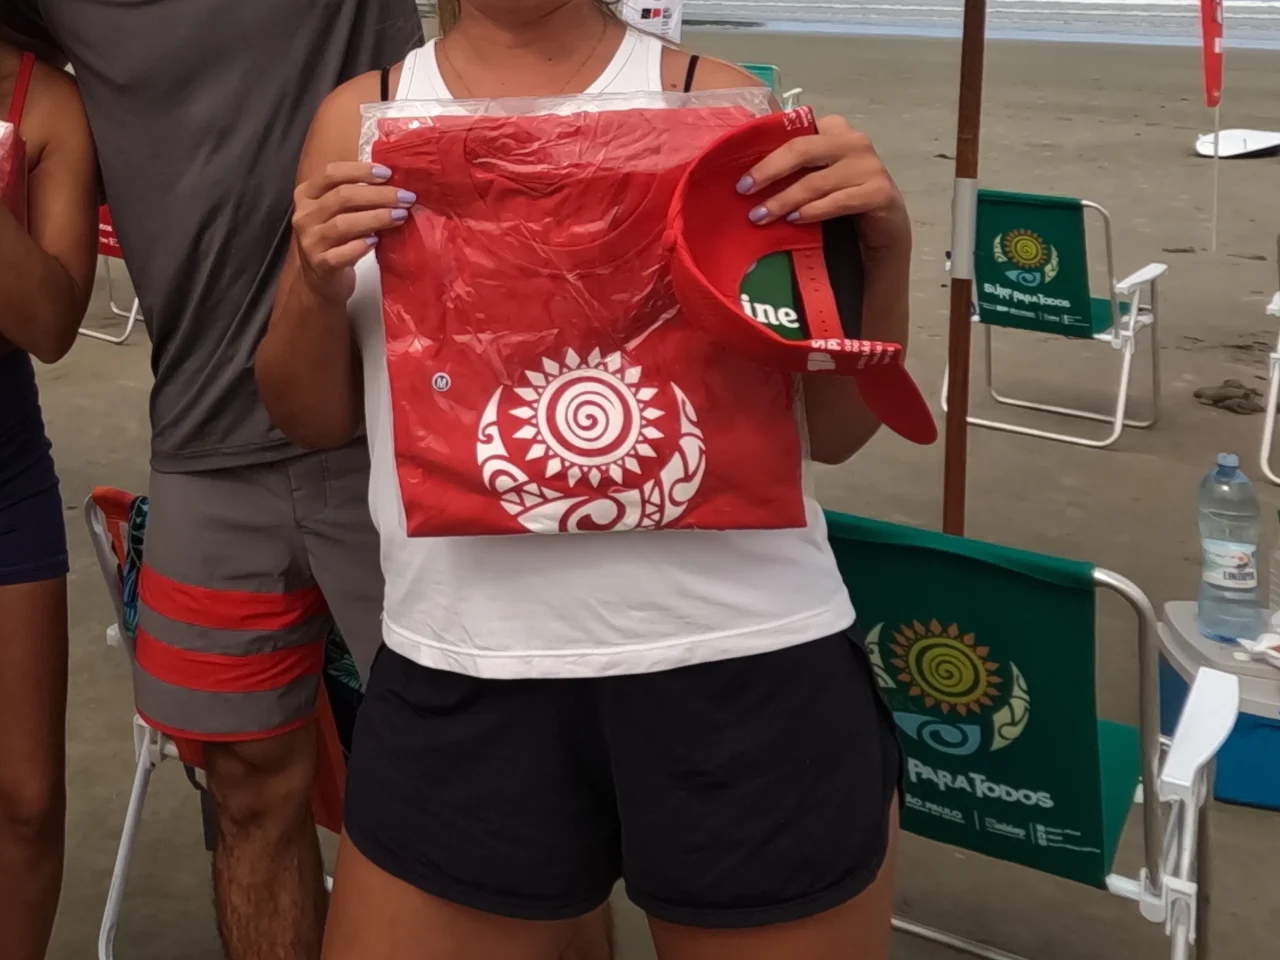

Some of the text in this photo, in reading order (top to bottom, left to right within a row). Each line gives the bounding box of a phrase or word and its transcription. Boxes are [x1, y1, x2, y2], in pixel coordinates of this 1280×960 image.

[983, 282, 1072, 308] SURF PARA TODOS
[740, 294, 800, 328] ine
[435, 376, 448, 389] M
[906, 756, 1055, 808] PARA TODOS
